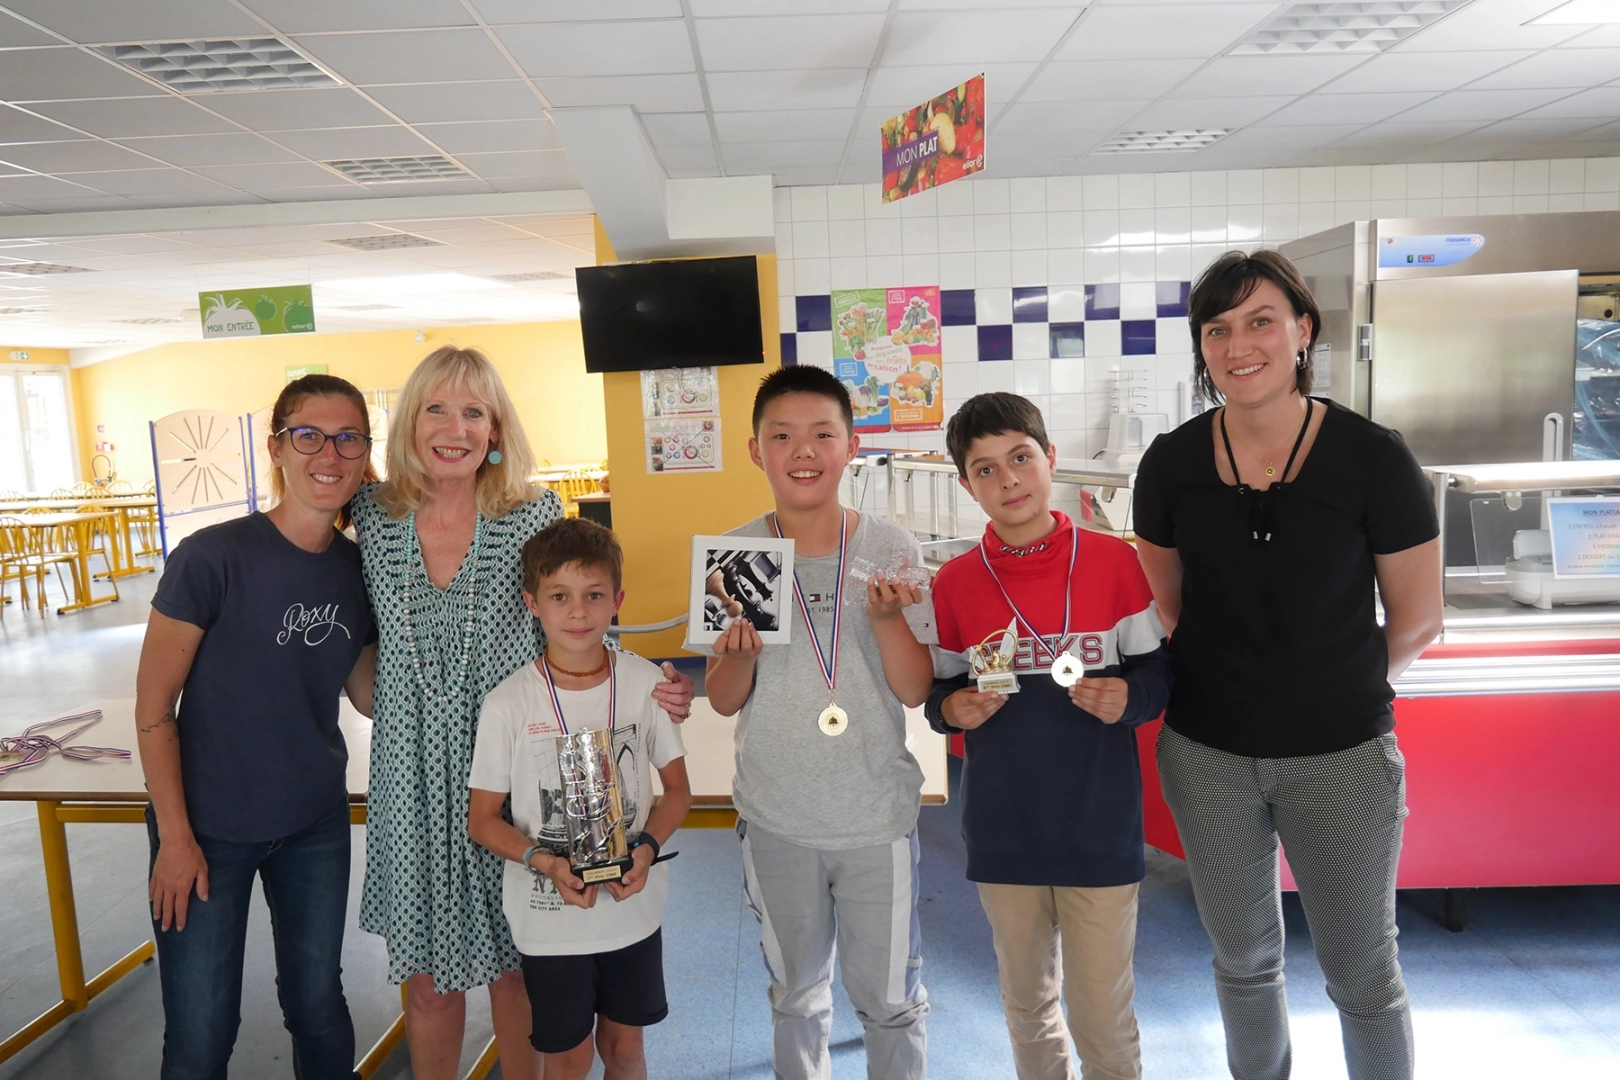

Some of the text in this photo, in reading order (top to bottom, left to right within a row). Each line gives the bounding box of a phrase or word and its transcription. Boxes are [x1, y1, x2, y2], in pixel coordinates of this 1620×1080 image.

[896, 136, 938, 167] MON PLAT
[207, 320, 254, 333] MON ENTRÉE
[886, 357, 907, 365] fruits
[818, 605, 835, 613] 1985
[276, 602, 351, 647] Roxy
